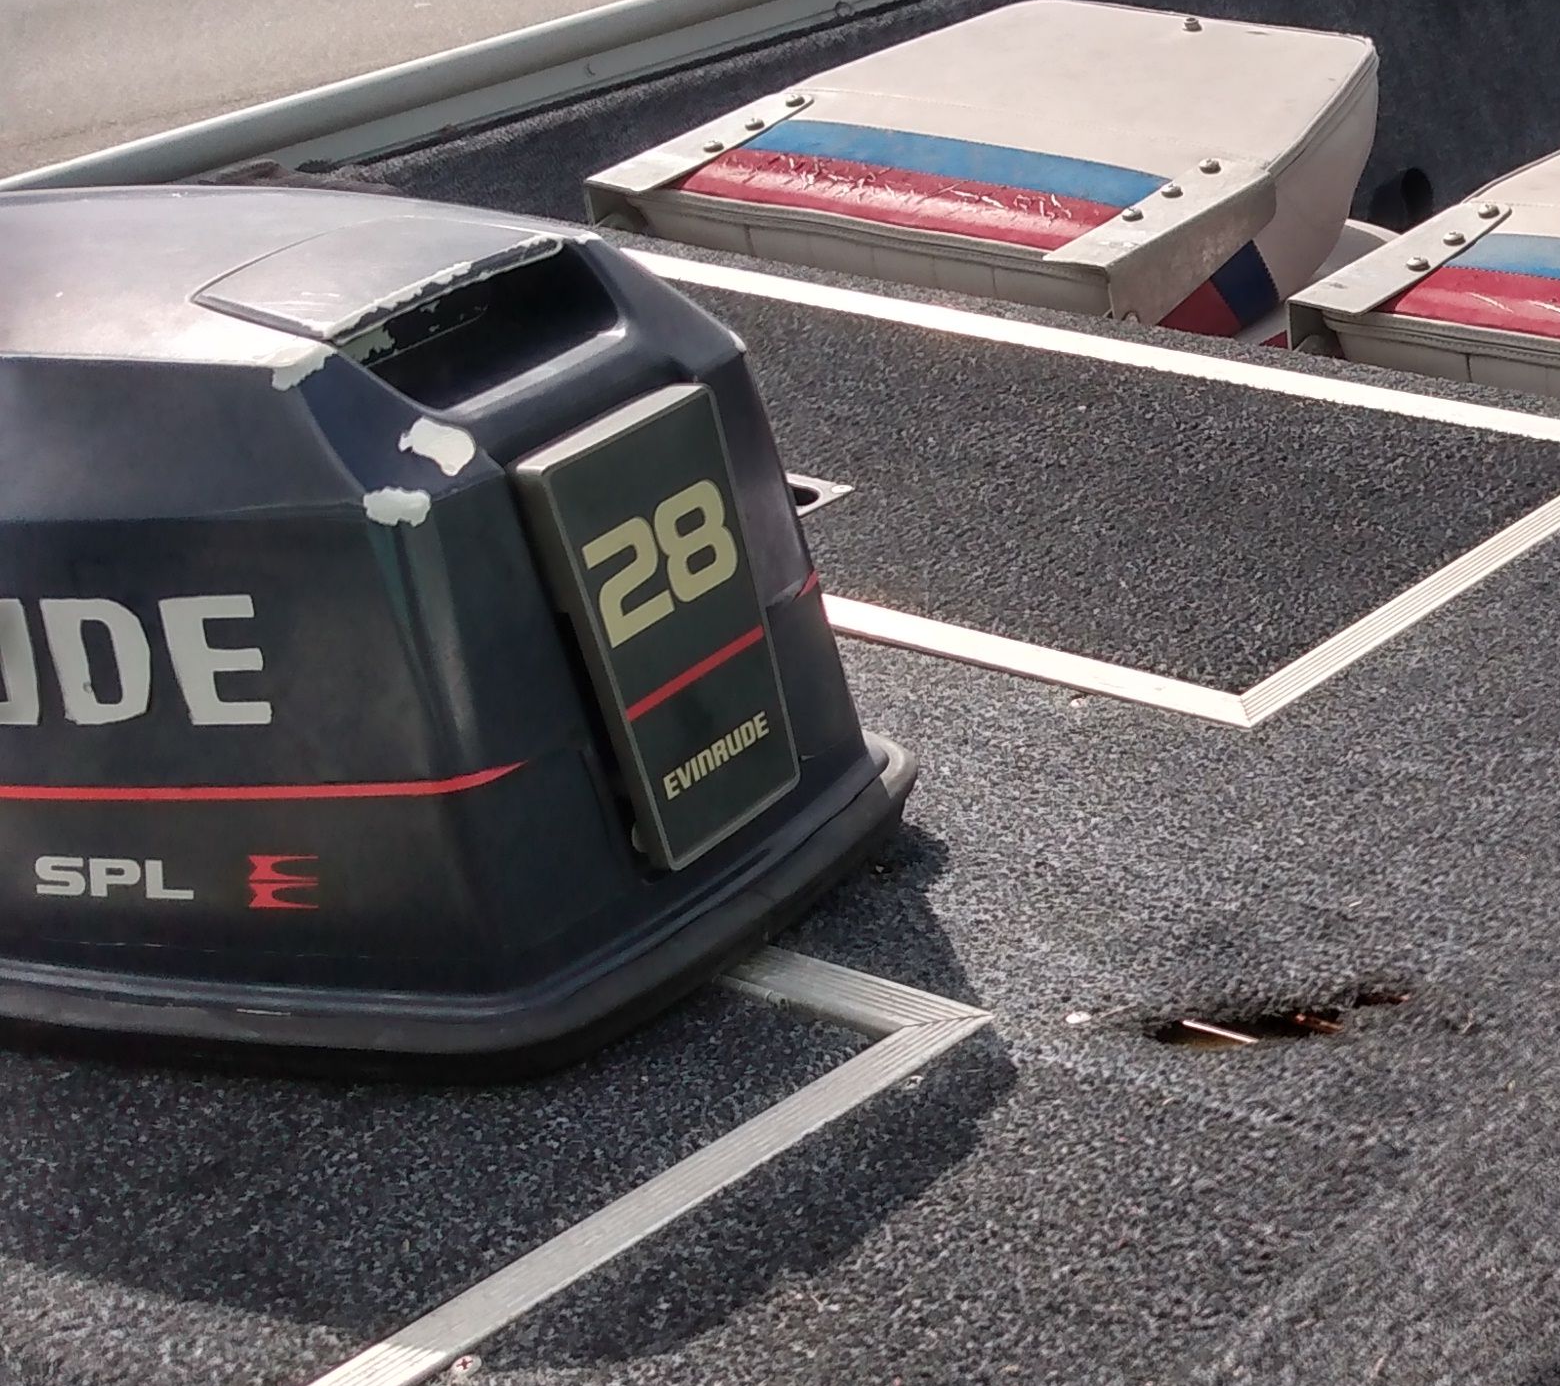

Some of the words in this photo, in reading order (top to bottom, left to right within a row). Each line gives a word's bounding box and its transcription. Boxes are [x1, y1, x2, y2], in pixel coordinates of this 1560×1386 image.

[582, 478, 738, 649] 28
[663, 710, 770, 801] EVINRUDE
[35, 855, 195, 901] SPL
